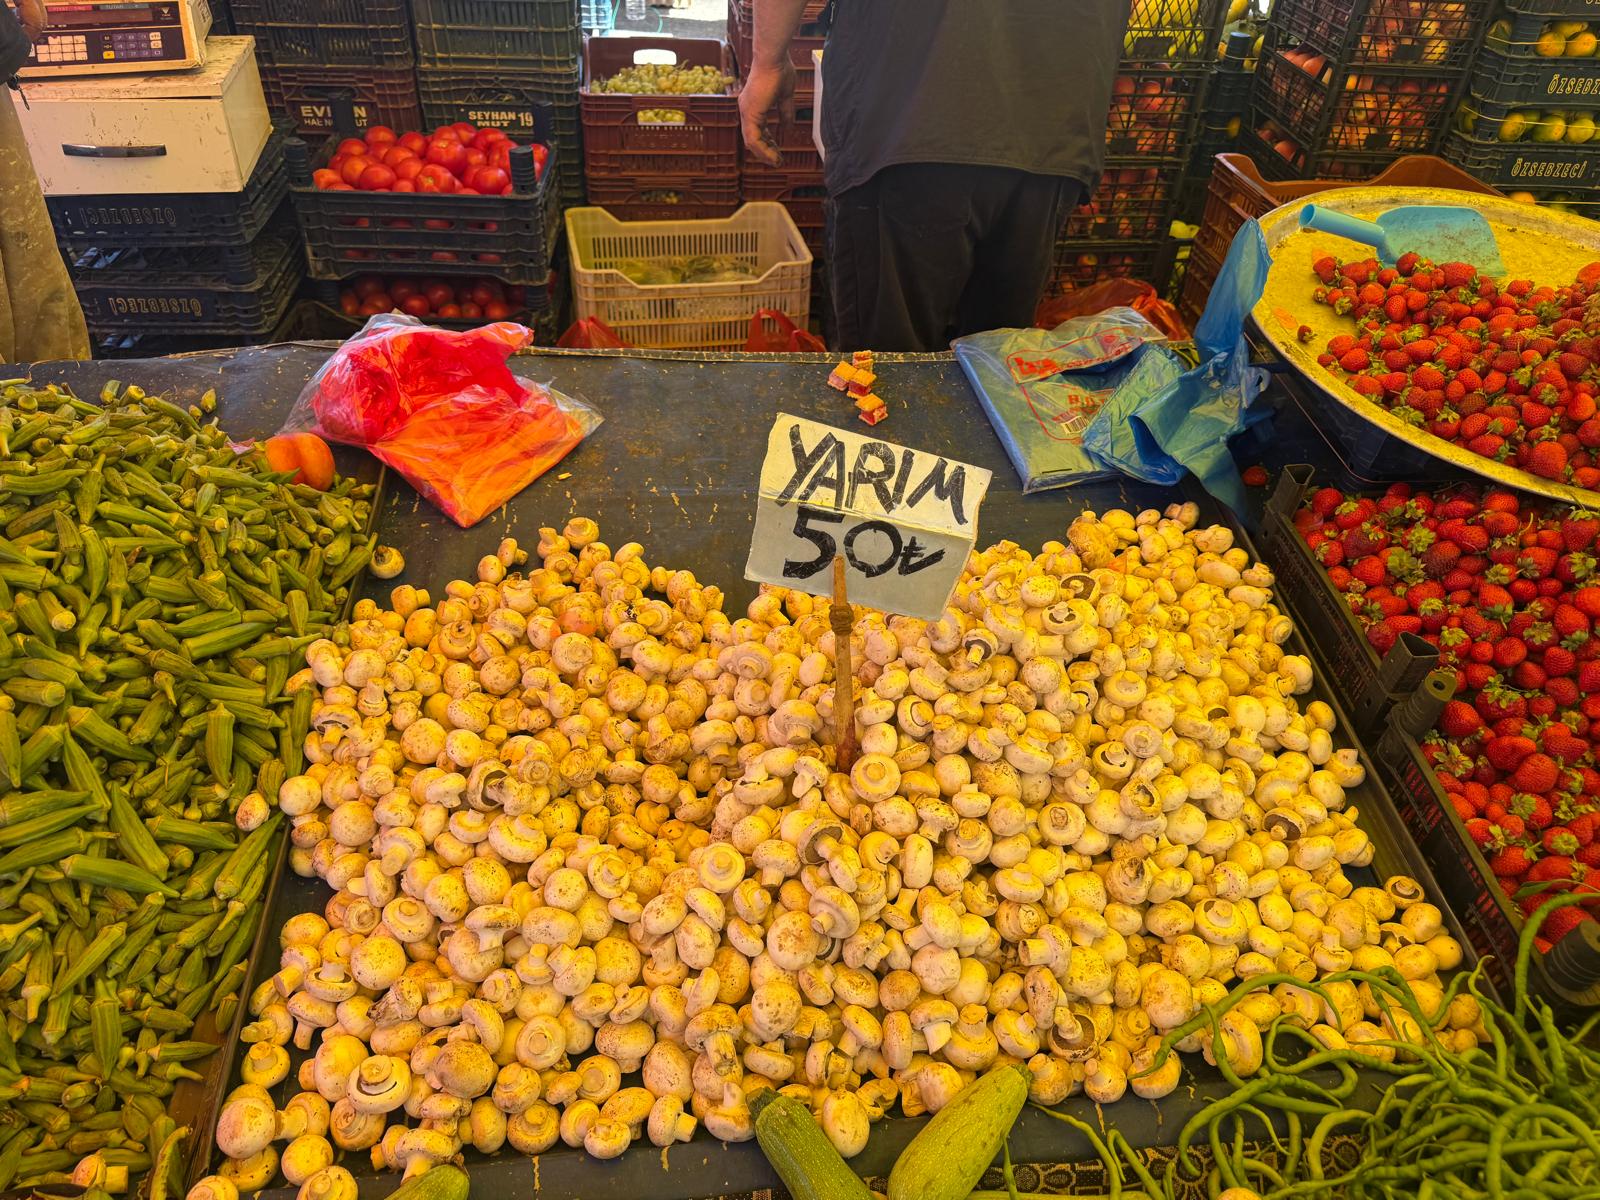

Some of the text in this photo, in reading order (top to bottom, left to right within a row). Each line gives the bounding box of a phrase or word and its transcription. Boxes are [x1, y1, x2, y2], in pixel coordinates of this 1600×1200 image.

[1547, 73, 1600, 95] ÖZSEBZ
[468, 111, 535, 127] SEYHAN 19
[774, 423, 968, 526] YARIM
